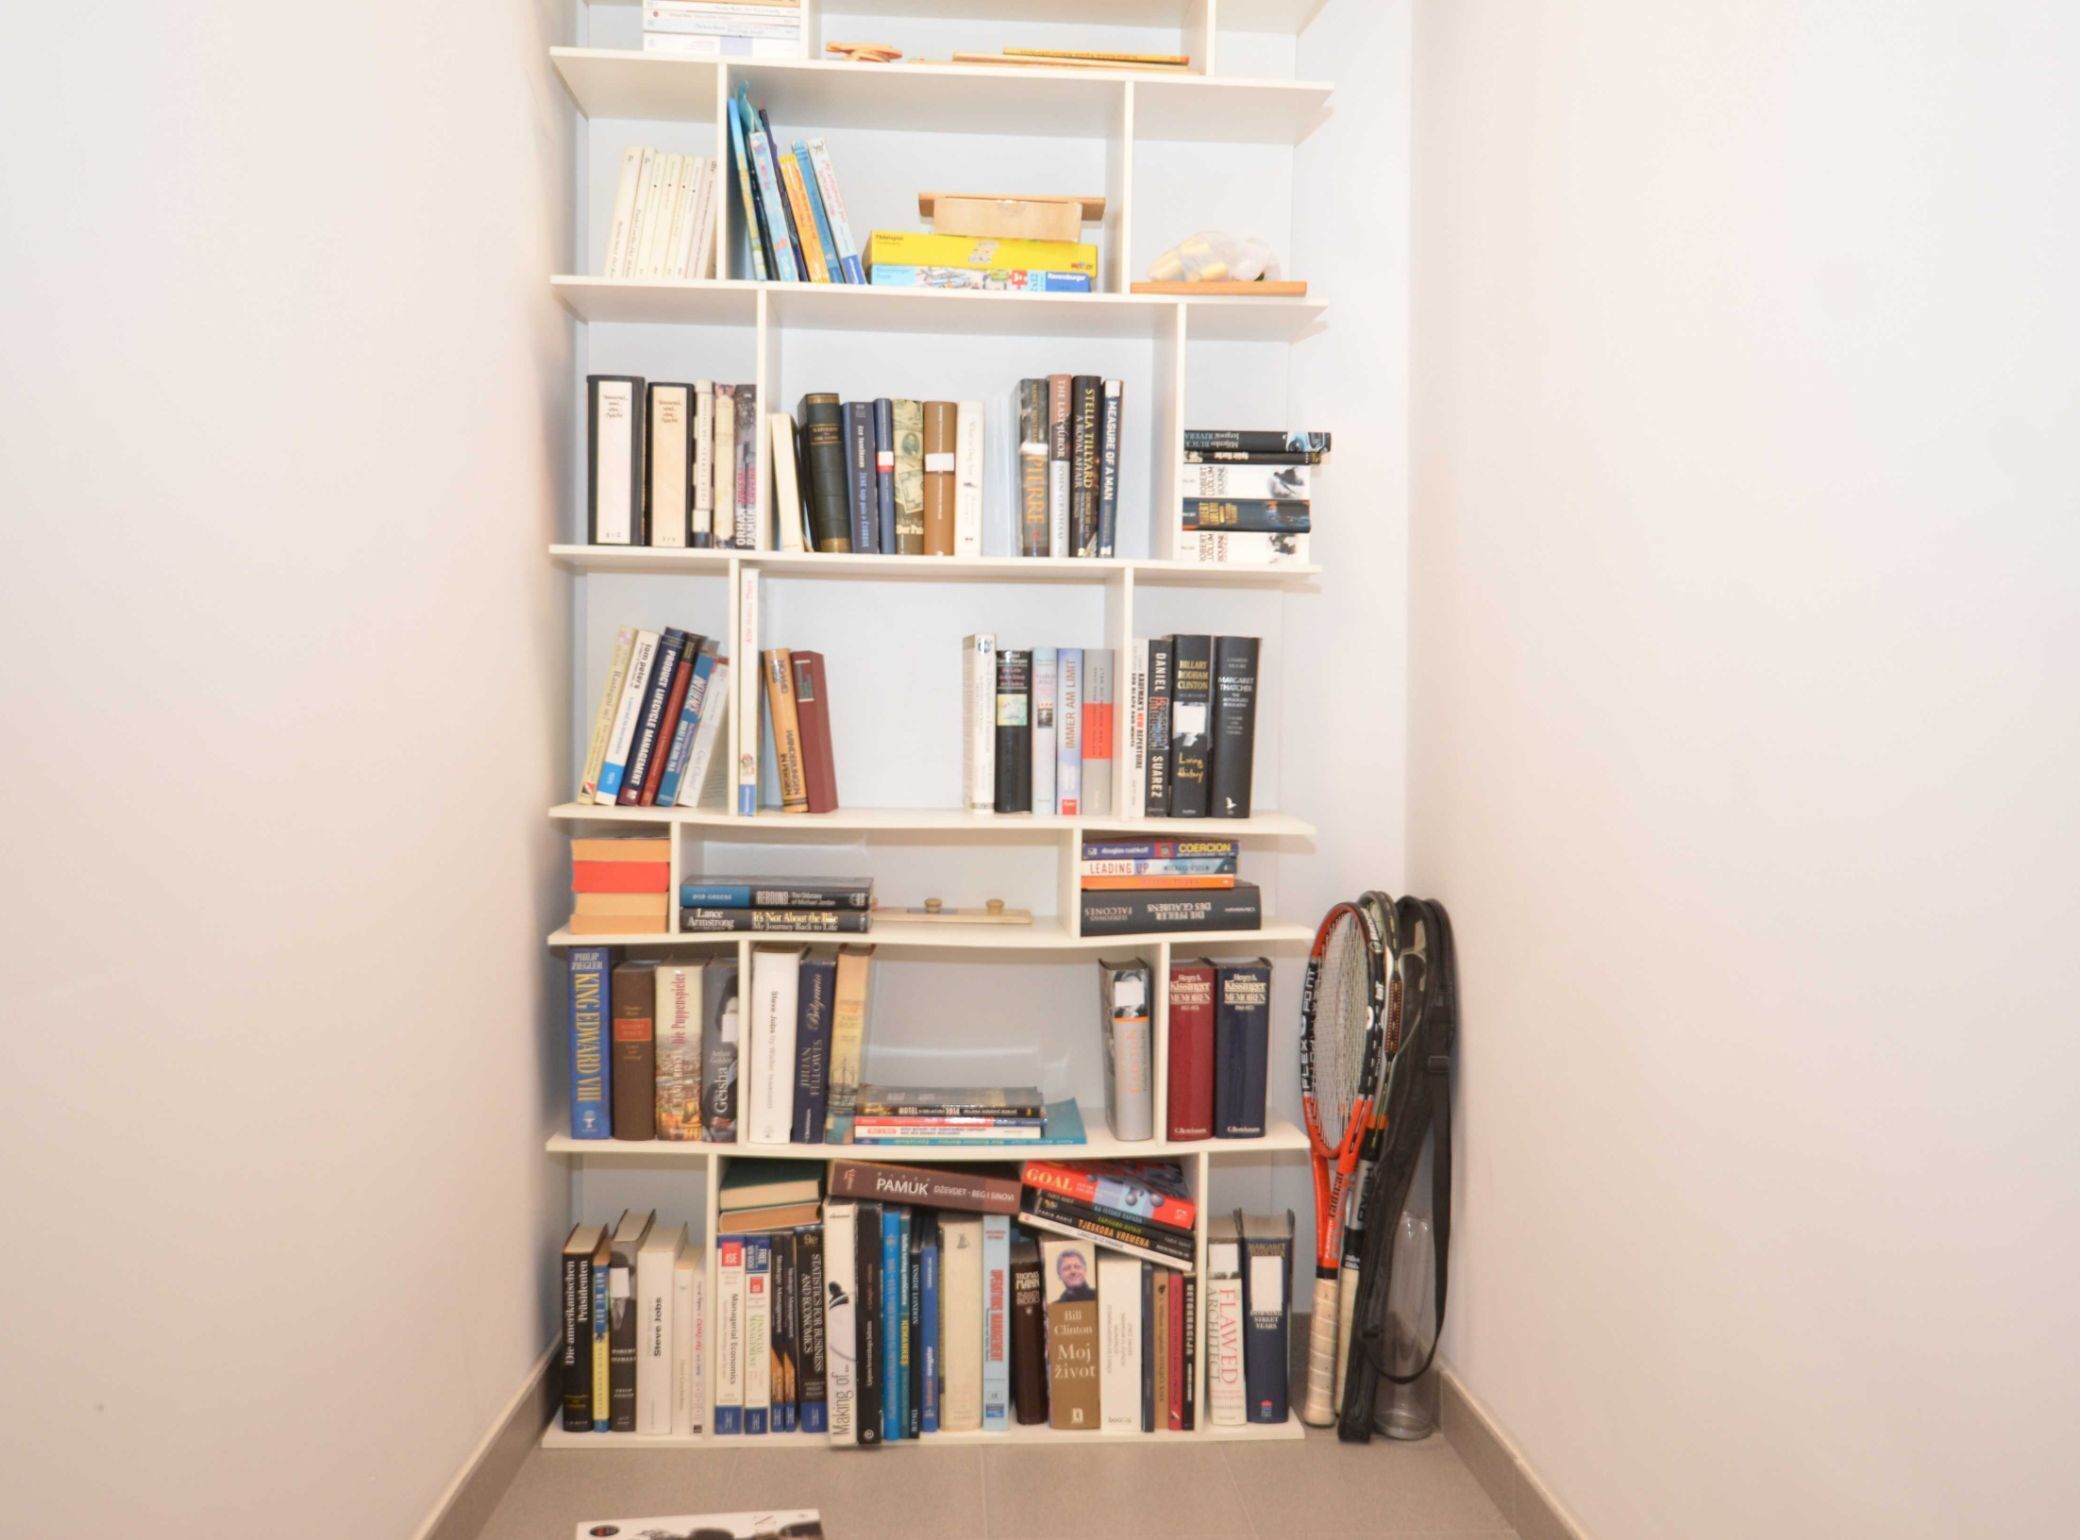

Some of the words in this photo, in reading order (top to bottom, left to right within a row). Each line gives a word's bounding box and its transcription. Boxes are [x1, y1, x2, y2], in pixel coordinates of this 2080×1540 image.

[1085, 388, 1095, 429] STELLA
[1105, 400, 1117, 449] MEASURE
[1075, 425, 1083, 455] ROYAL
[1083, 433, 1094, 488] TILLYARD
[1105, 451, 1115, 465] OF
[1105, 467, 1114, 475] A
[1103, 477, 1114, 500] MAN
[1056, 496, 1064, 540] GRISHAM
[657, 648, 677, 688] PRODUCT
[1065, 660, 1077, 688] LIMIT
[1155, 652, 1166, 692] DANIEL
[1178, 671, 1208, 680] RODHAM
[1179, 661, 1207, 670] HILLARY
[1177, 681, 1208, 689] CLINTON
[1218, 676, 1254, 684] MARGARET
[1219, 684, 1252, 692] THATCHER
[646, 687, 666, 729] LIFECYCLE
[1065, 692, 1076, 709] AM
[1065, 712, 1077, 749] IMMER
[630, 728, 655, 787] MANAGEMENT
[780, 753, 787, 762] IN
[785, 730, 801, 795] WANDERUNGEN
[1151, 756, 1164, 798] SUAREZ
[1178, 843, 1231, 852] COERCION
[1090, 864, 1132, 874] LEADING
[1136, 863, 1149, 873] UP
[696, 908, 723, 918] Lance
[752, 912, 764, 922] It's
[766, 912, 782, 922] Not
[784, 912, 807, 922] About
[809, 913, 820, 922] the
[821, 913, 839, 922] Bike
[1084, 907, 1133, 915] FALCONES
[1147, 903, 1193, 912] GLAUBENS
[1155, 911, 1188, 920] PFEILER
[1191, 911, 1205, 919] DIE
[1195, 902, 1212, 911] DES
[687, 918, 734, 929] Armstrong
[752, 923, 763, 931] My
[765, 923, 793, 931] Journey
[795, 923, 812, 931] Back
[823, 923, 838, 931] Life
[572, 961, 603, 970] ZIEGLER
[574, 952, 599, 962] PHILIP
[575, 973, 600, 1009] KING
[1170, 982, 1211, 993] Kissinger
[1224, 982, 1267, 992] Kissinger
[1224, 992, 1266, 1001] MEMOIREN
[1303, 969, 1316, 1012] POINT
[671, 974, 689, 1029] Puppenspieler
[770, 991, 778, 1013] Steve
[770, 1014, 778, 1034] Jobs
[576, 1013, 600, 1075] EDWARD
[672, 1032, 683, 1044] Die
[800, 1046, 811, 1088] JULIAN
[810, 1039, 823, 1096] FELLOWES
[1300, 1039, 1313, 1090] FLEX
[576, 1078, 602, 1102] VIII
[715, 1067, 728, 1113] Geisha
[875, 1178, 929, 1196] PAMUK
[1024, 1166, 1075, 1192] GOAL
[933, 1185, 967, 1197] DŽEVDET
[971, 1190, 986, 1199] BEG
[990, 1193, 1015, 1202] SINOVI
[1076, 1220, 1115, 1238] TJESKOBA
[1115, 1230, 1151, 1248] VREMENA
[802, 1274, 812, 1295] AND
[812, 1254, 821, 1306] STATISTICS
[1015, 1271, 1039, 1280] THOMAS
[1015, 1279, 1040, 1289] MANN
[577, 1260, 589, 1323] Präsidenten
[991, 1269, 1003, 1311] OPERATIONS
[566, 1261, 575, 1343] amerikanischen
[654, 1297, 662, 1323] Jobs
[775, 1287, 783, 1334] Management
[730, 1293, 739, 1340] Managerial
[802, 1296, 812, 1354] ECONOMICS
[813, 1308, 822, 1326] FOR
[1064, 1310, 1082, 1321] Bill
[654, 1325, 662, 1357] Steve
[990, 1313, 1003, 1362] MANAGEMENT
[1053, 1324, 1093, 1336] Clinton
[1208, 1287, 1220, 1383] ARCHITECT
[1219, 1288, 1239, 1385] FLAWED
[566, 1345, 575, 1365] Die
[814, 1328, 823, 1372] BUSINESS
[1058, 1344, 1091, 1363] Moj
[730, 1342, 738, 1385] Economics
[1054, 1363, 1096, 1378] život
[832, 1364, 849, 1386] of...
[832, 1390, 853, 1436] Making
